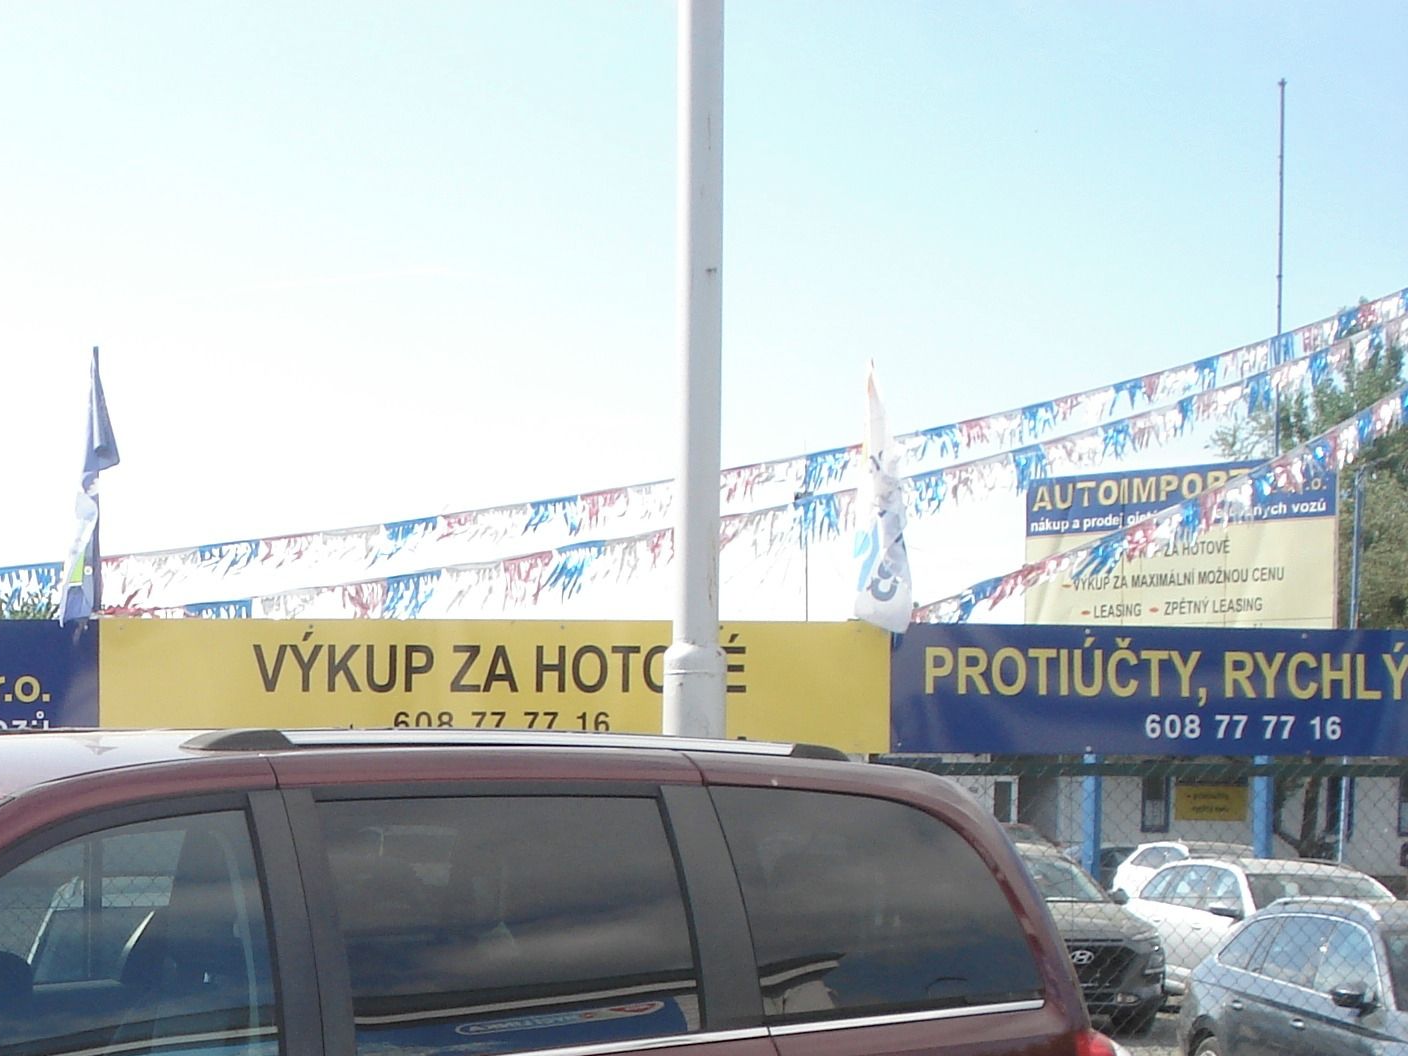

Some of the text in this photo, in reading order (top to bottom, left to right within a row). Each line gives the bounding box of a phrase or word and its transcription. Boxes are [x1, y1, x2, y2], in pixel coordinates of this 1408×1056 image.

[1072, 519, 1080, 529] a
[1083, 512, 1123, 532] prodej
[1113, 575, 1128, 589] ZA
[1252, 567, 1285, 582] CENU
[1094, 603, 1142, 618] LEASING
[1212, 597, 1263, 613] LEASING
[252, 633, 747, 693] VÝKUP ZA HOTOÉ
[925, 637, 1208, 708] PROTIÚČTY,
[1145, 714, 1342, 741] 608 77 77 16
